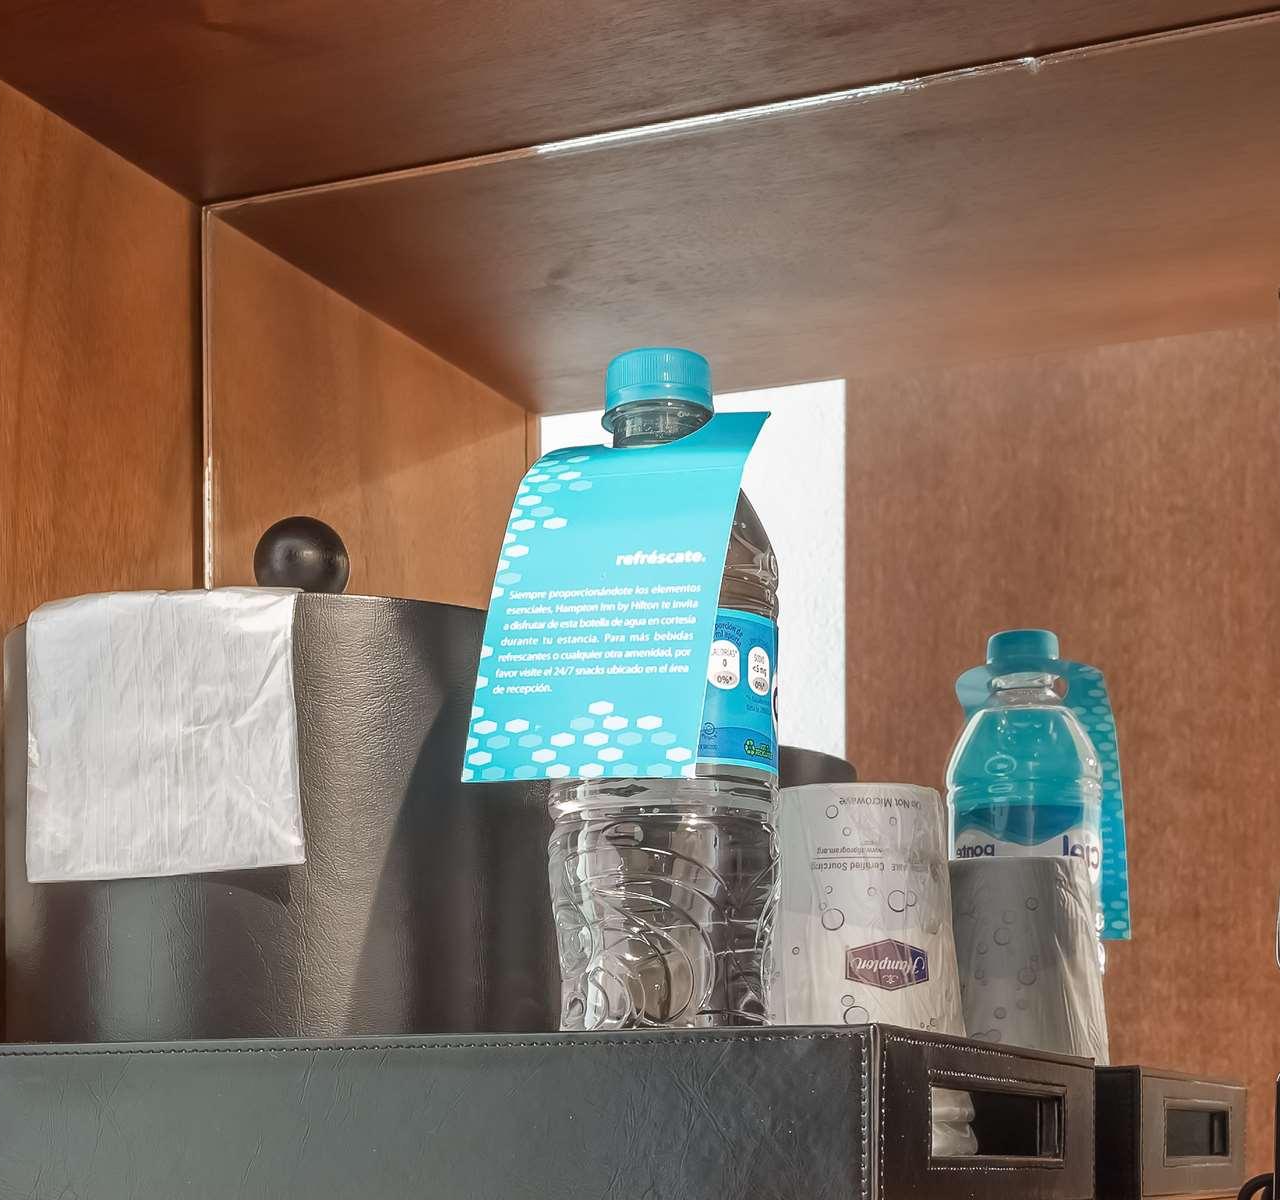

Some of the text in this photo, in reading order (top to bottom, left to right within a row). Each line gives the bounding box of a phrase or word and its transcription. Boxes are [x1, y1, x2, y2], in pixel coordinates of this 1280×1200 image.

[509, 591, 547, 600] Siempre
[634, 585, 649, 594] los
[651, 584, 701, 594] elementos
[555, 603, 599, 614] Hampton
[600, 603, 615, 611] Inn
[617, 602, 629, 612] by
[630, 601, 659, 610] Hilton
[661, 601, 671, 609] te
[672, 600, 699, 608] invita
[503, 623, 509, 631] a
[510, 621, 545, 630] disfrutar
[546, 620, 558, 630] de
[560, 620, 578, 629] esta
[579, 619, 609, 628] botella
[611, 618, 623, 627] de
[624, 618, 646, 628] agua
[501, 632, 694, 646] durante tu estancia. Para más bebidas
[498, 653, 550, 663] refrescantes
[560, 650, 602, 661] cualquier
[604, 650, 623, 658] otra
[624, 648, 673, 658] amenidad,
[675, 649, 692, 658] por
[496, 669, 519, 678] favor
[519, 668, 542, 677] visite
[543, 667, 553, 676] el
[553, 666, 574, 676] 24/7
[575, 665, 604, 675] snacks
[607, 665, 644, 674] ubicado
[659, 664, 668, 673] el
[492, 683, 552, 695] de recepción.
[894, 798, 910, 808] Not
